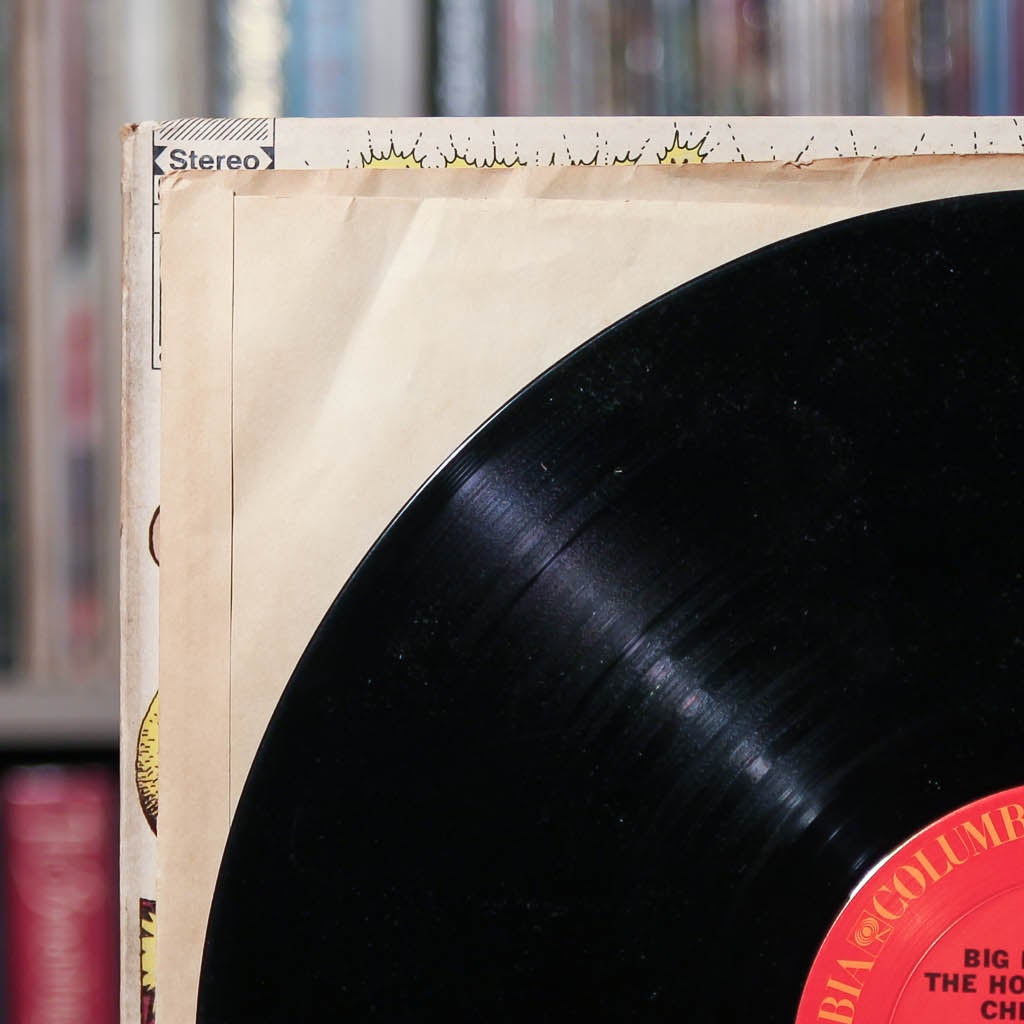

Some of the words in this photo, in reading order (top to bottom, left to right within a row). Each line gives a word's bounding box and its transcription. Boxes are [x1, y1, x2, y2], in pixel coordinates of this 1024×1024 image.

[169, 148, 260, 170] Stereo
[963, 948, 1010, 970] BIG
[923, 971, 977, 994] THE
